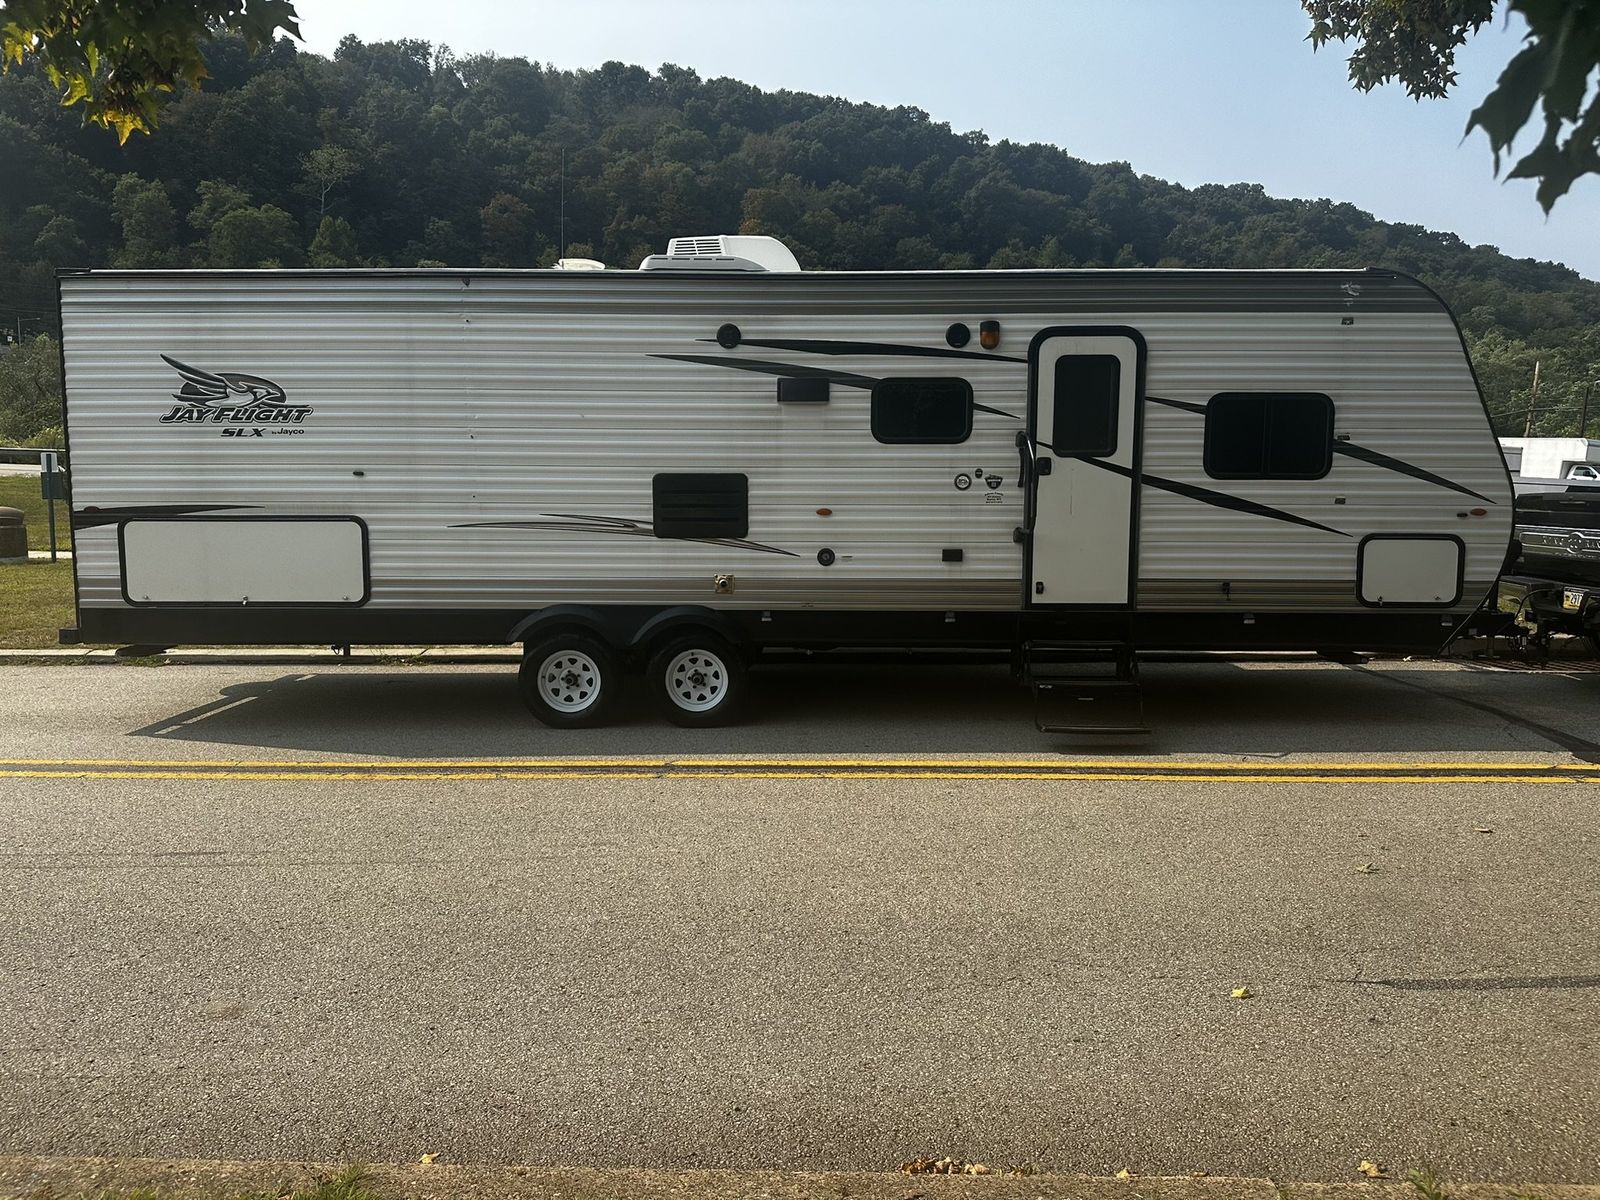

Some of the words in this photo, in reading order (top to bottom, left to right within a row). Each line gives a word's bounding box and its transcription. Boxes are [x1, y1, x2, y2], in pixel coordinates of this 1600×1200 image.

[160, 406, 211, 422] JAY
[212, 406, 313, 422] FLIGHT
[220, 428, 267, 437] SLX
[277, 427, 305, 436] Jayco
